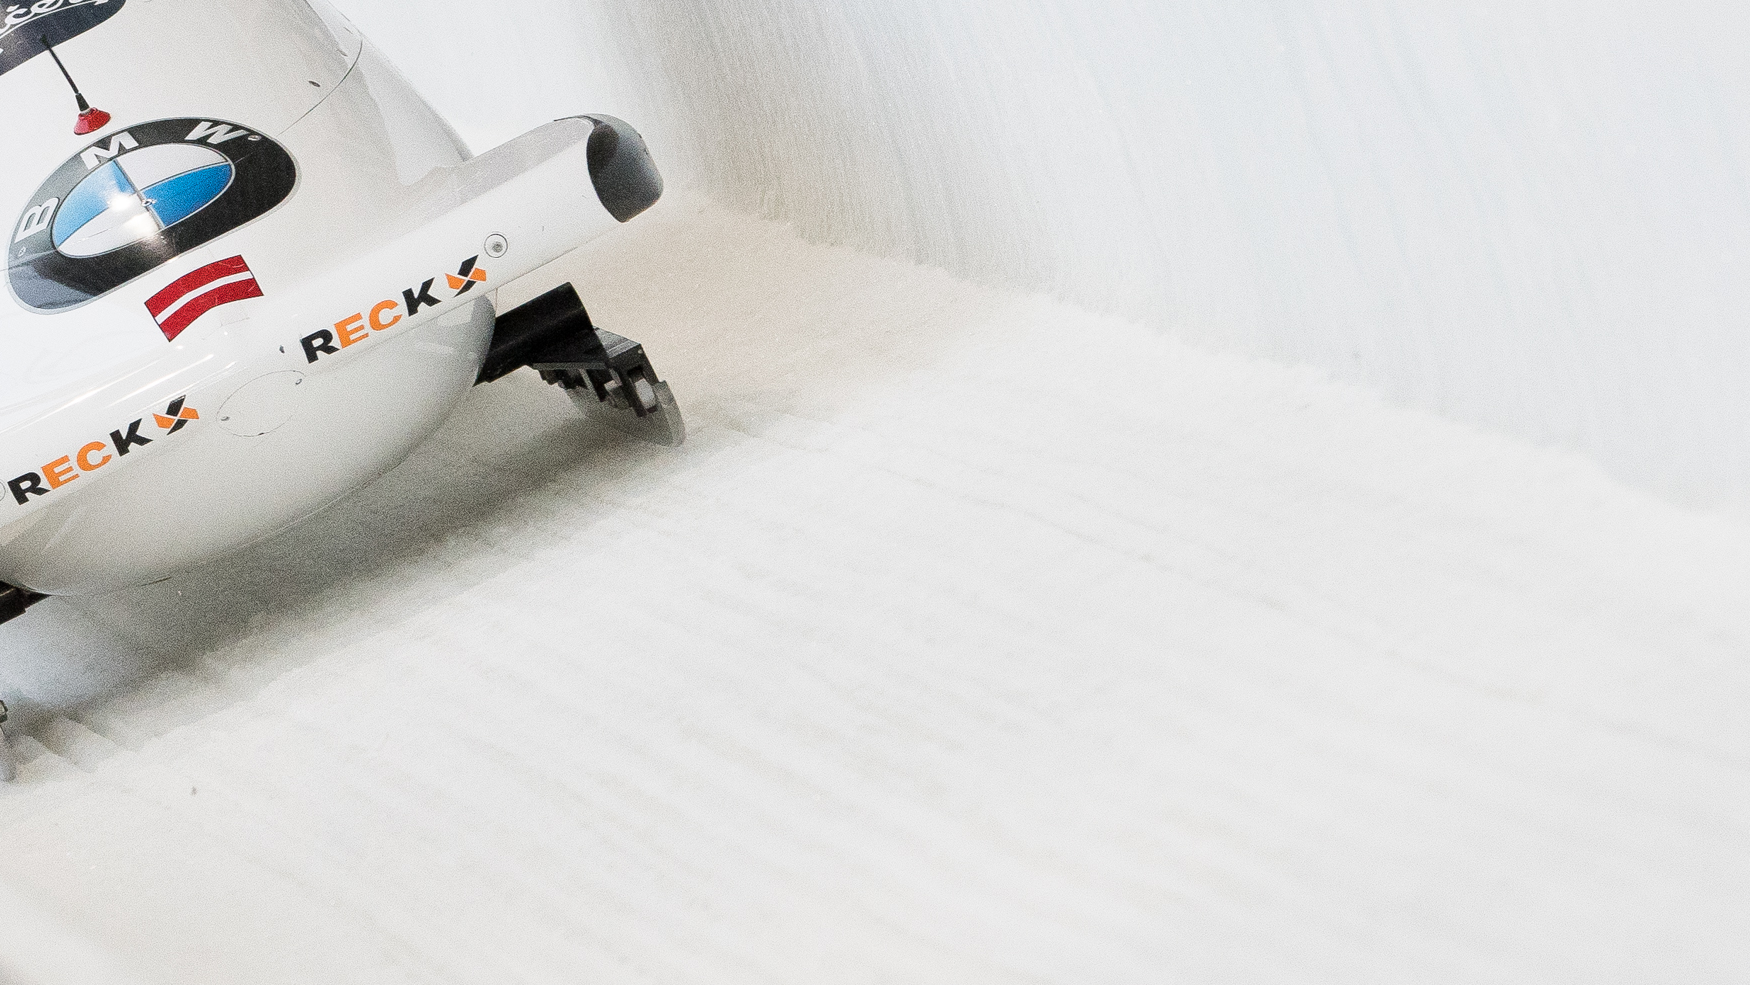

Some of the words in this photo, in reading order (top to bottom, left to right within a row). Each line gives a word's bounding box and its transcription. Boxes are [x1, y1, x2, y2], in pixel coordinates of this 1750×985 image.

[13, 120, 250, 244] BMW
[302, 276, 442, 364] RECK
[7, 418, 153, 505] RECK
